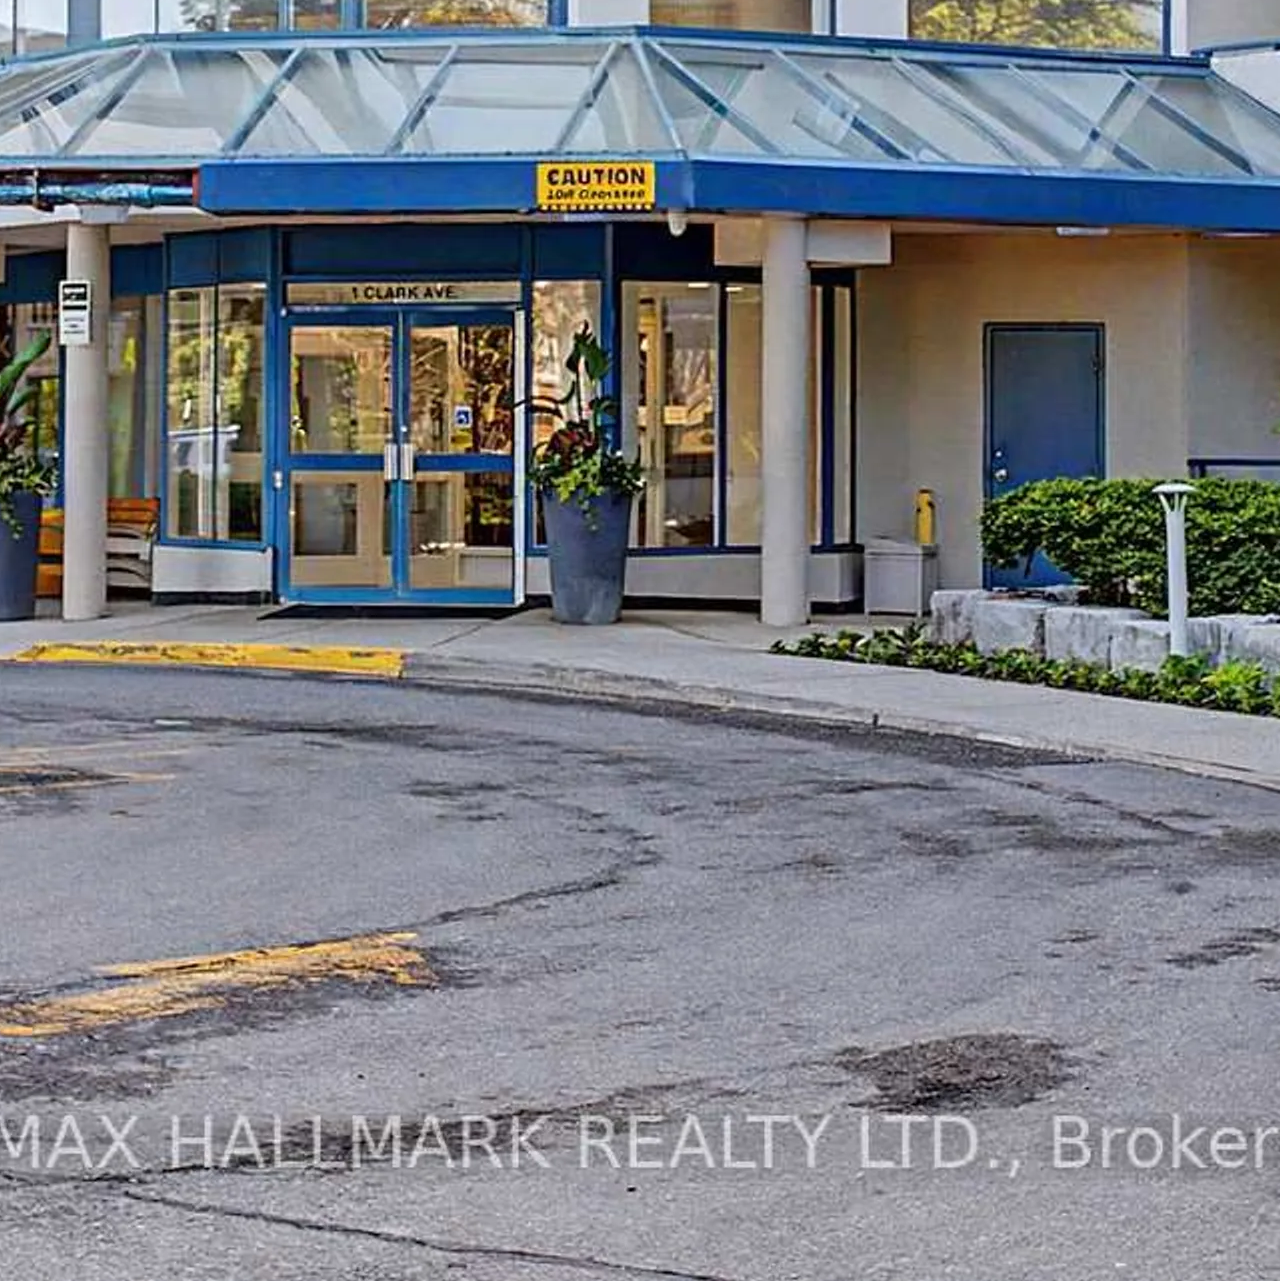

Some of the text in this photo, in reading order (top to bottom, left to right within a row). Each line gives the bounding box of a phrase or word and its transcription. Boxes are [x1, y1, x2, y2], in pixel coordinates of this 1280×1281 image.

[547, 168, 645, 185] CAUTION
[352, 286, 357, 299] 1
[364, 286, 417, 299] CLARK
